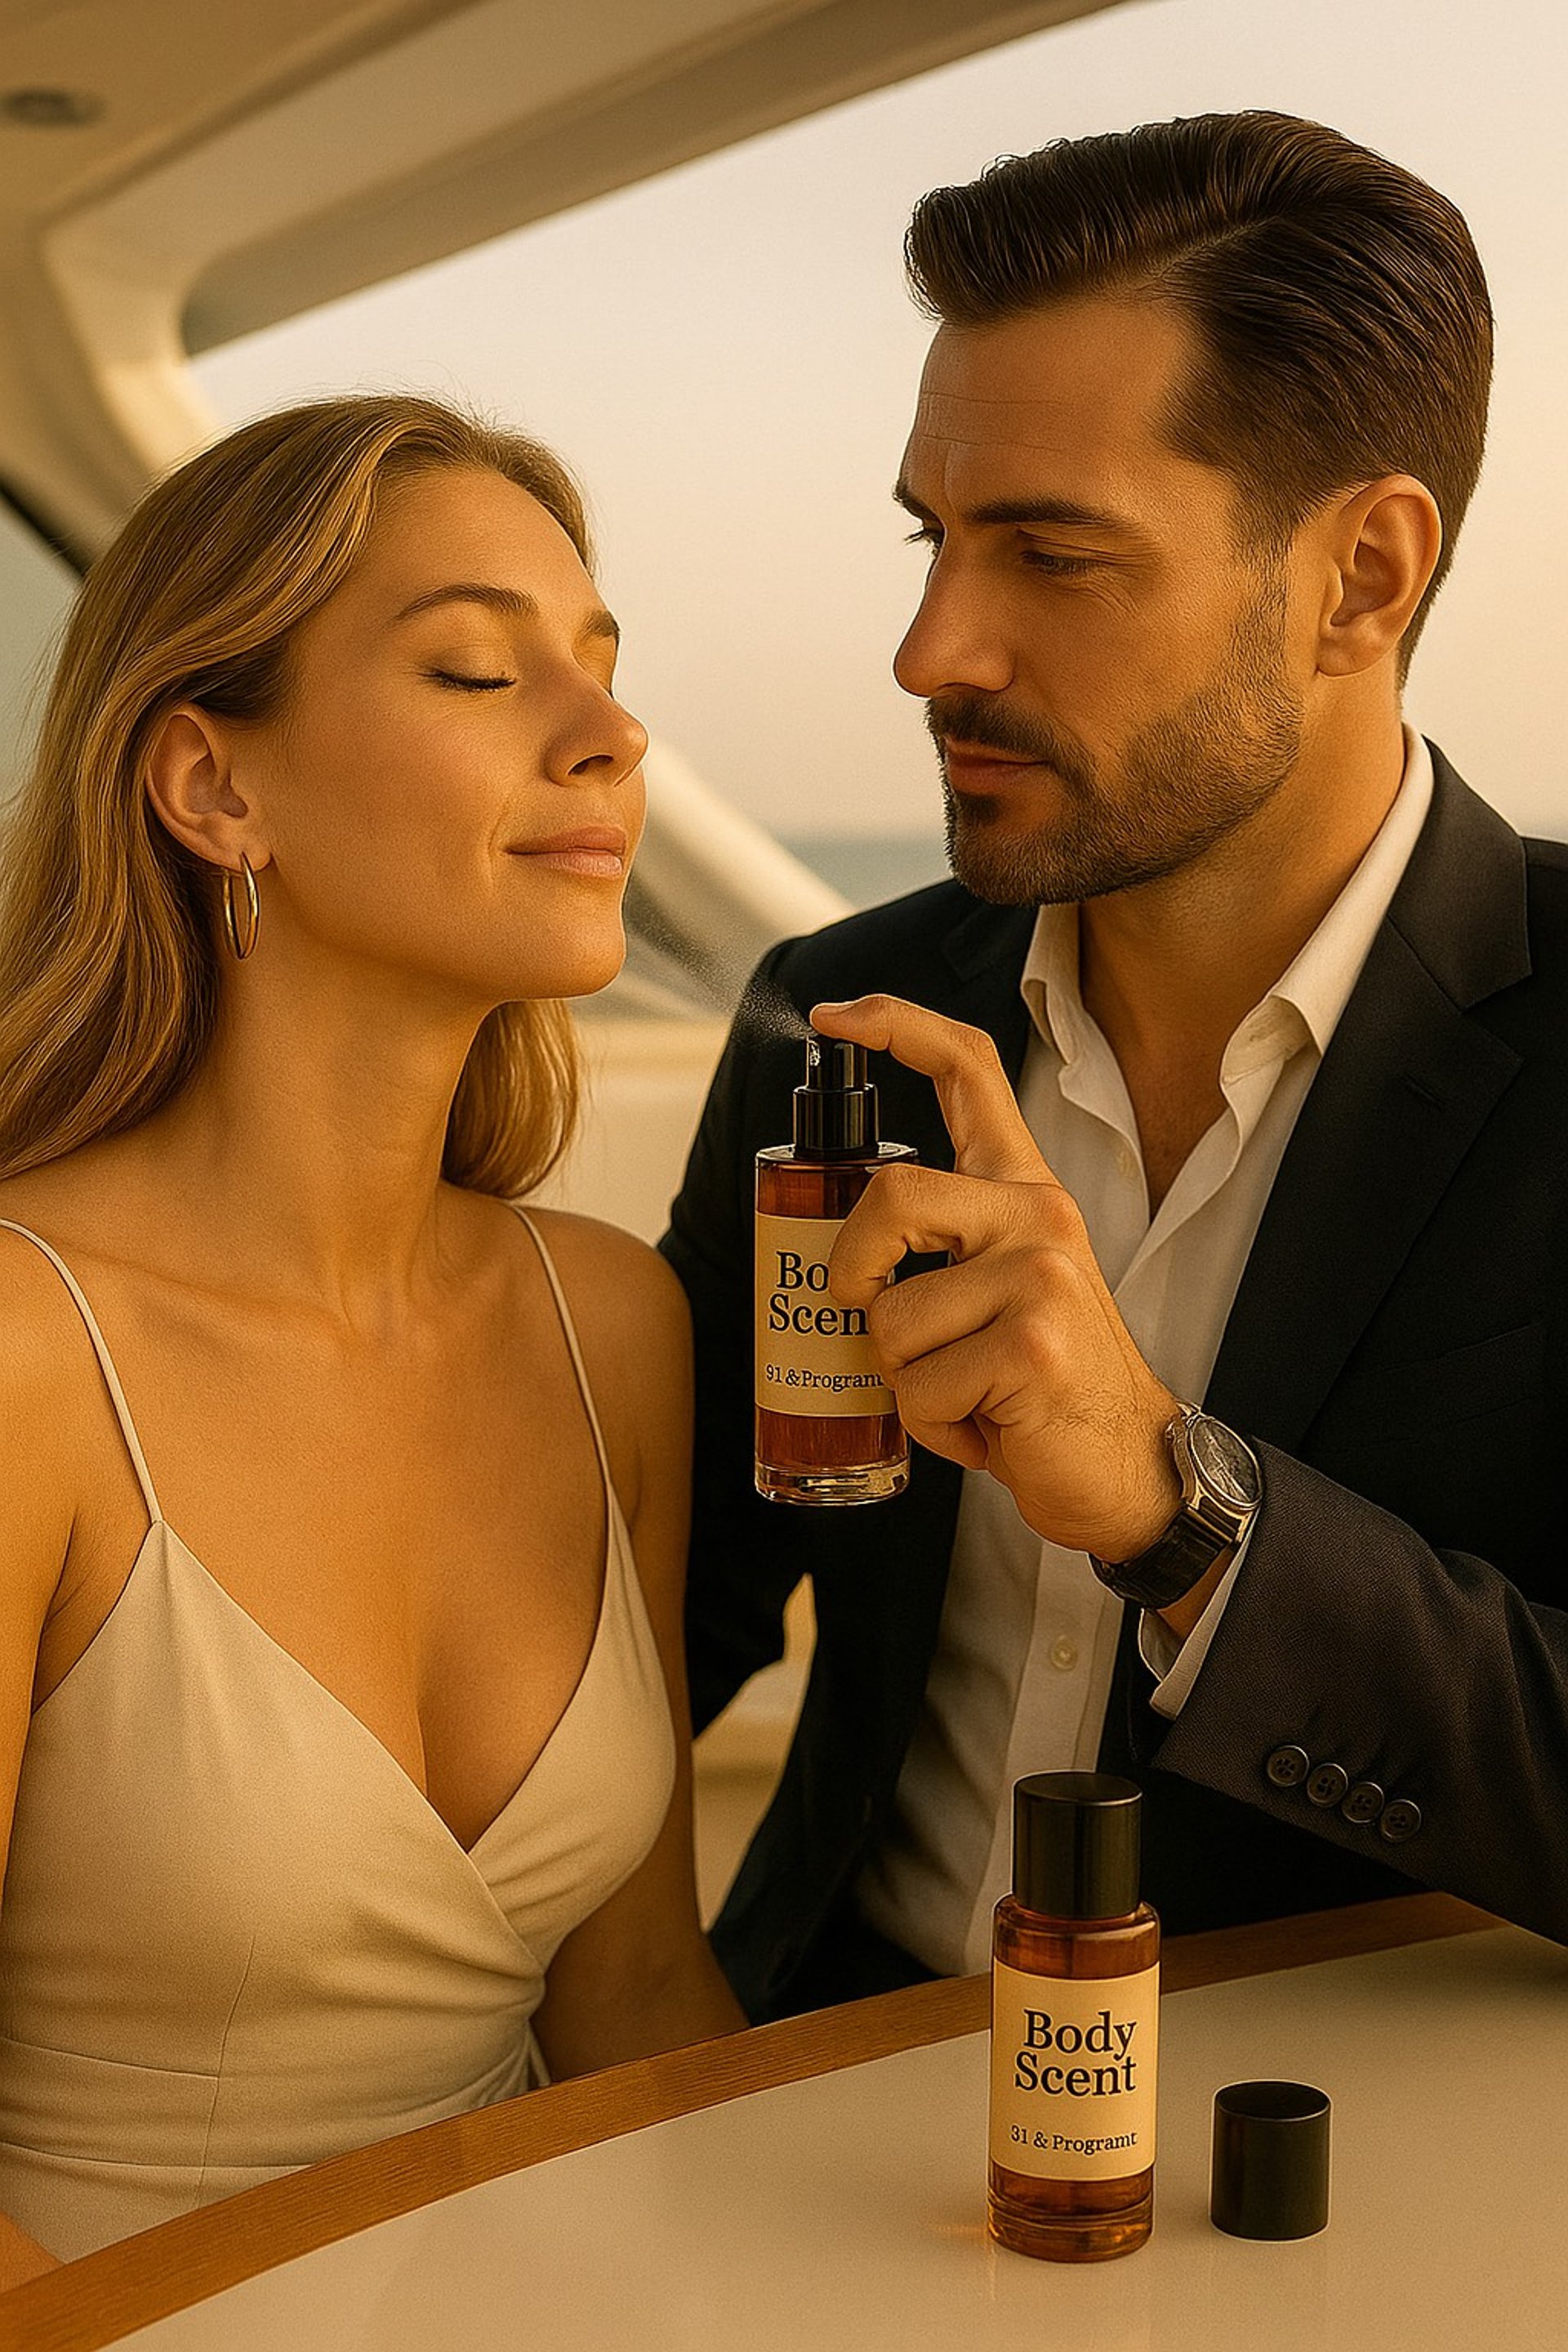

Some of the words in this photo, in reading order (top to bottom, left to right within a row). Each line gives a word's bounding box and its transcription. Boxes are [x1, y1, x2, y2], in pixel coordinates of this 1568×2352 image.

[776, 1251, 829, 1291] Bo
[769, 1294, 869, 1335] Scen
[766, 1364, 782, 1383] 91
[1023, 2009, 1137, 2060] Body
[1015, 2051, 1136, 2096] Scent
[1012, 2125, 1027, 2144] 31
[1034, 2132, 1047, 2148] &
[1053, 2133, 1137, 2155] Programt
